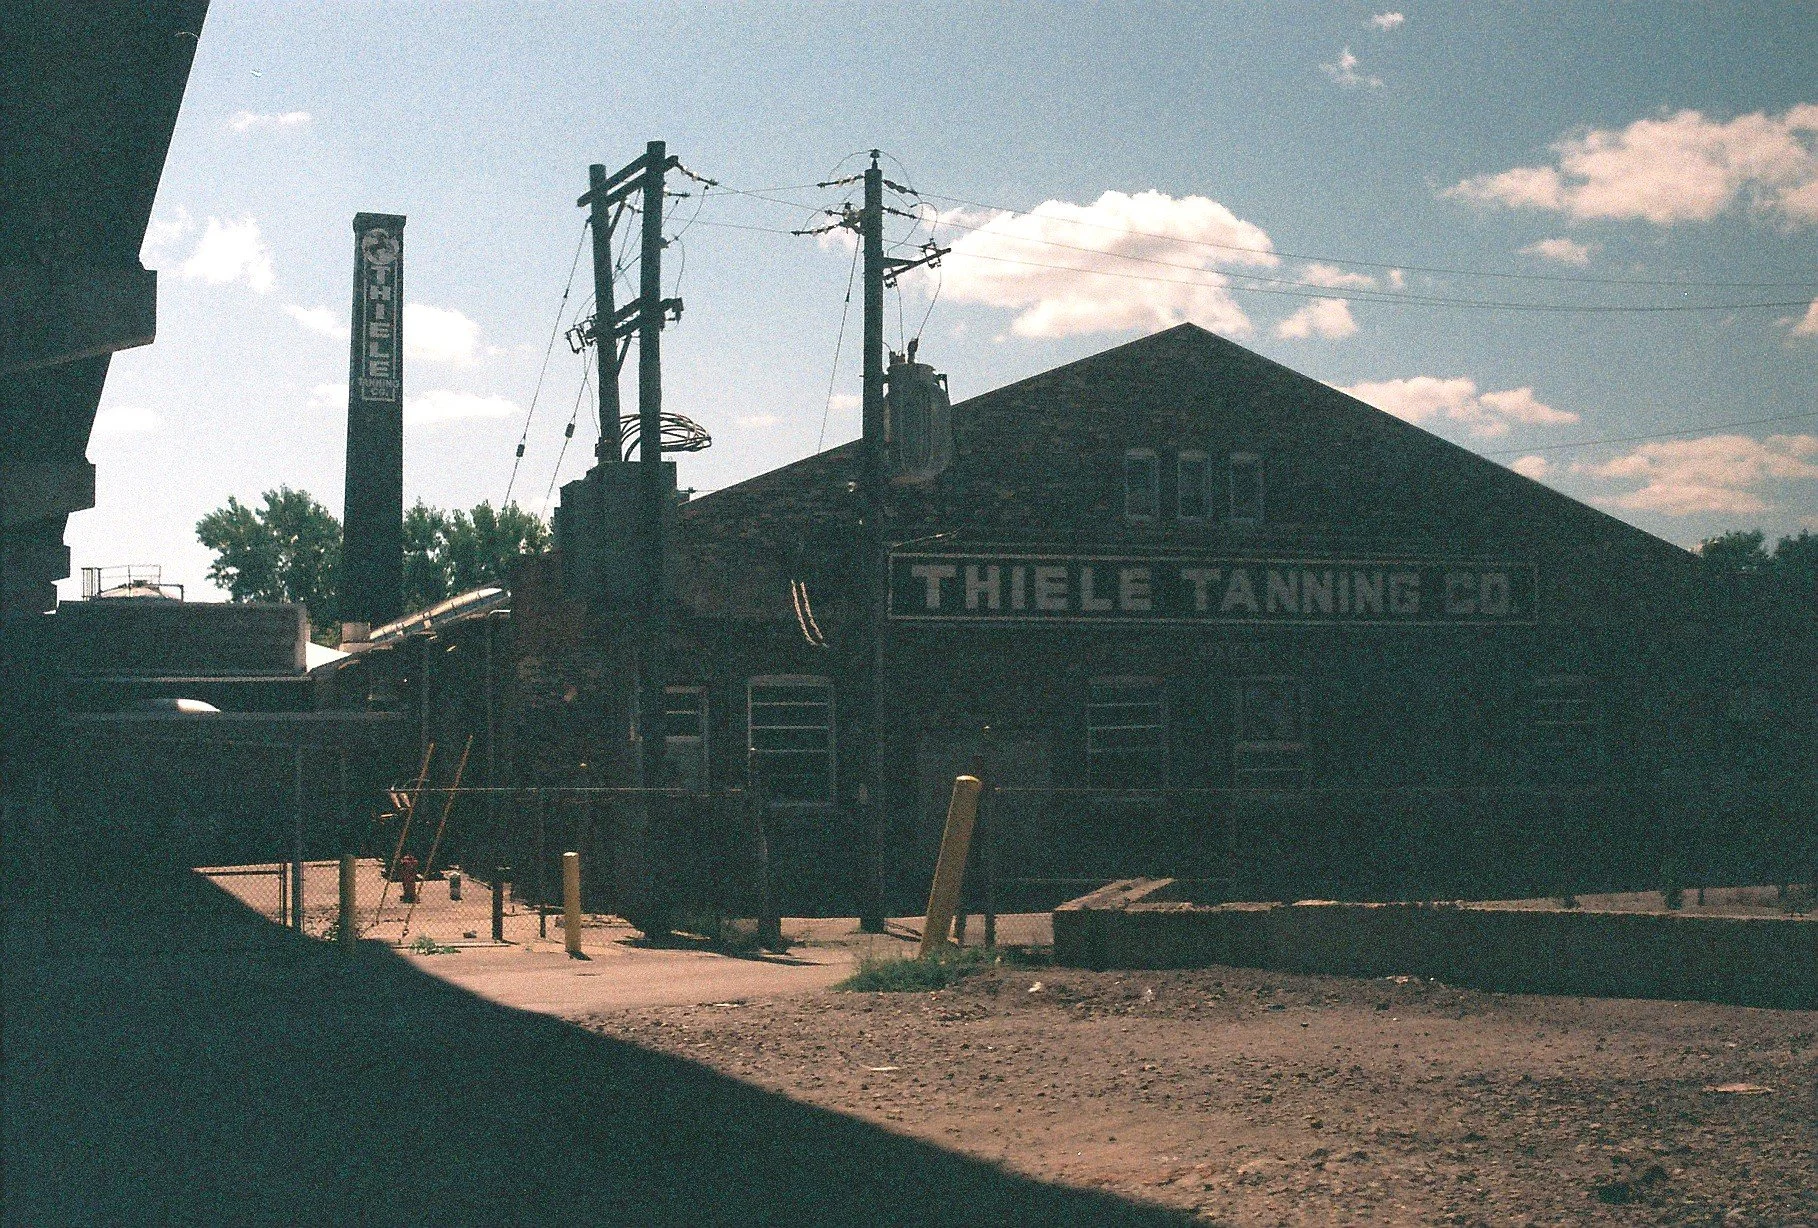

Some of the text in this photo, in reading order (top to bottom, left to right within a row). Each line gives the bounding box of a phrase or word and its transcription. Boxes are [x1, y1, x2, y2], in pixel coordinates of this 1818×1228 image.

[369, 266, 391, 377] THIELE
[911, 564, 1153, 612] THIELE
[1181, 568, 1422, 615] TANNING
